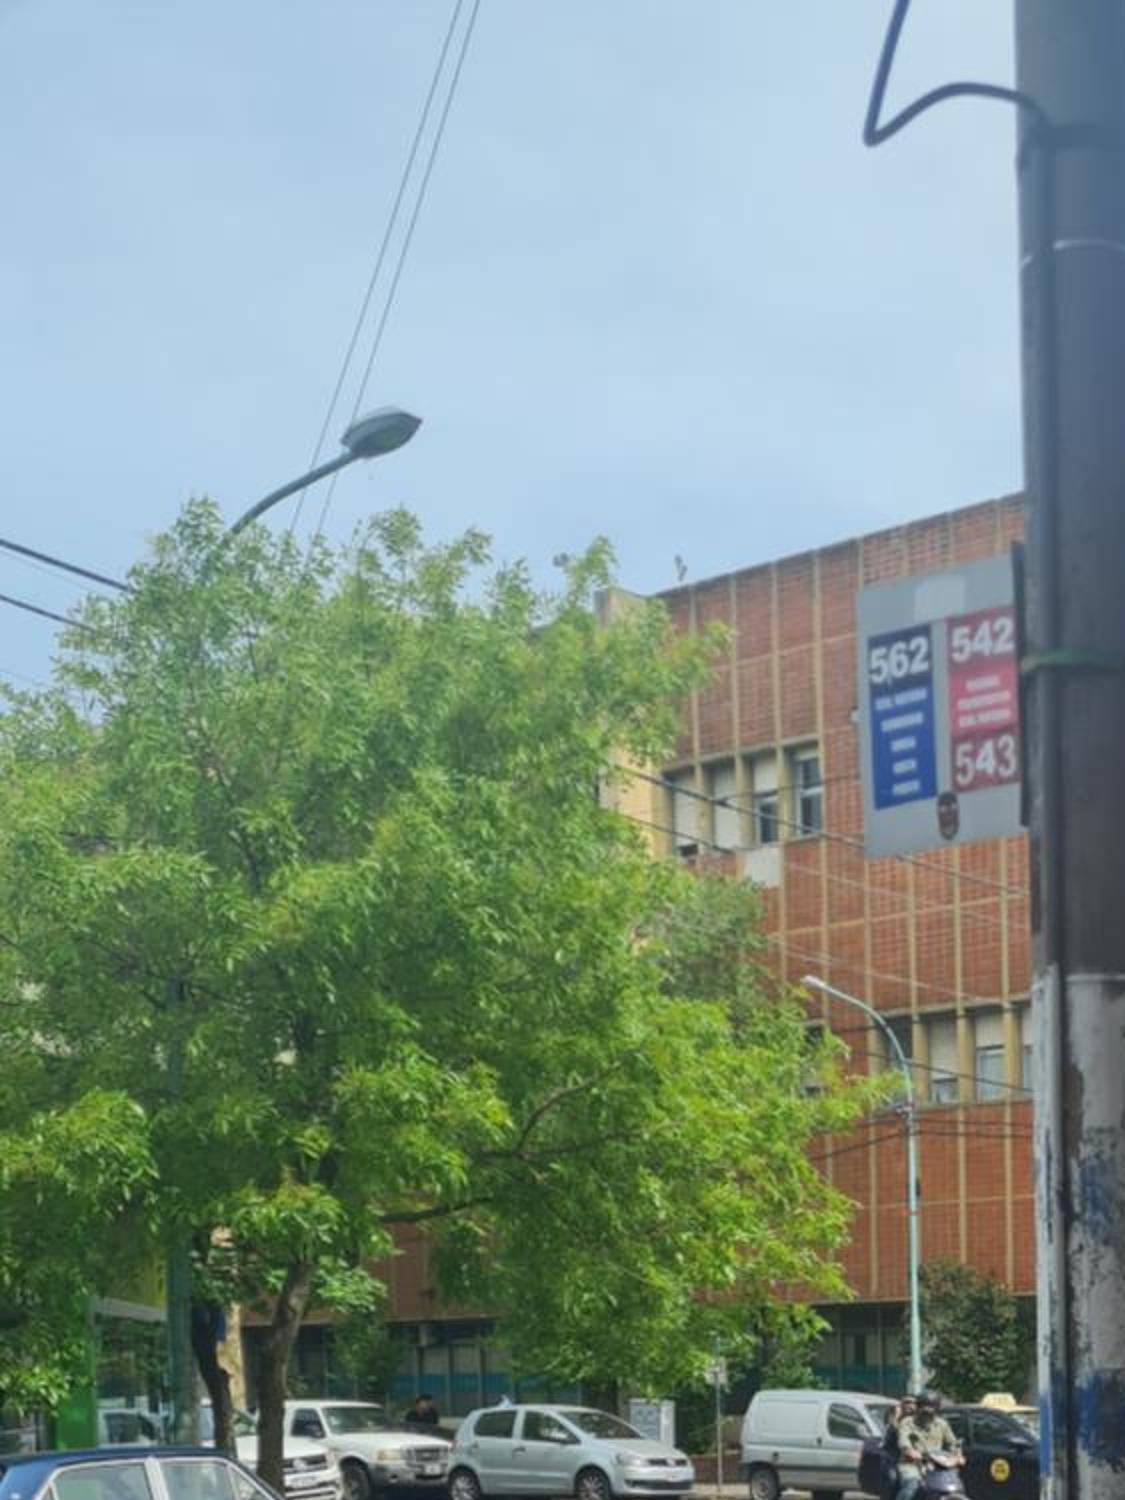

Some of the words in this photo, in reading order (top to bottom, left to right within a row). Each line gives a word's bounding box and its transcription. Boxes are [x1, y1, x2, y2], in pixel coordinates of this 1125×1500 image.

[869, 637, 929, 684] 562
[952, 617, 1015, 663] 542
[954, 735, 1018, 787] 543
